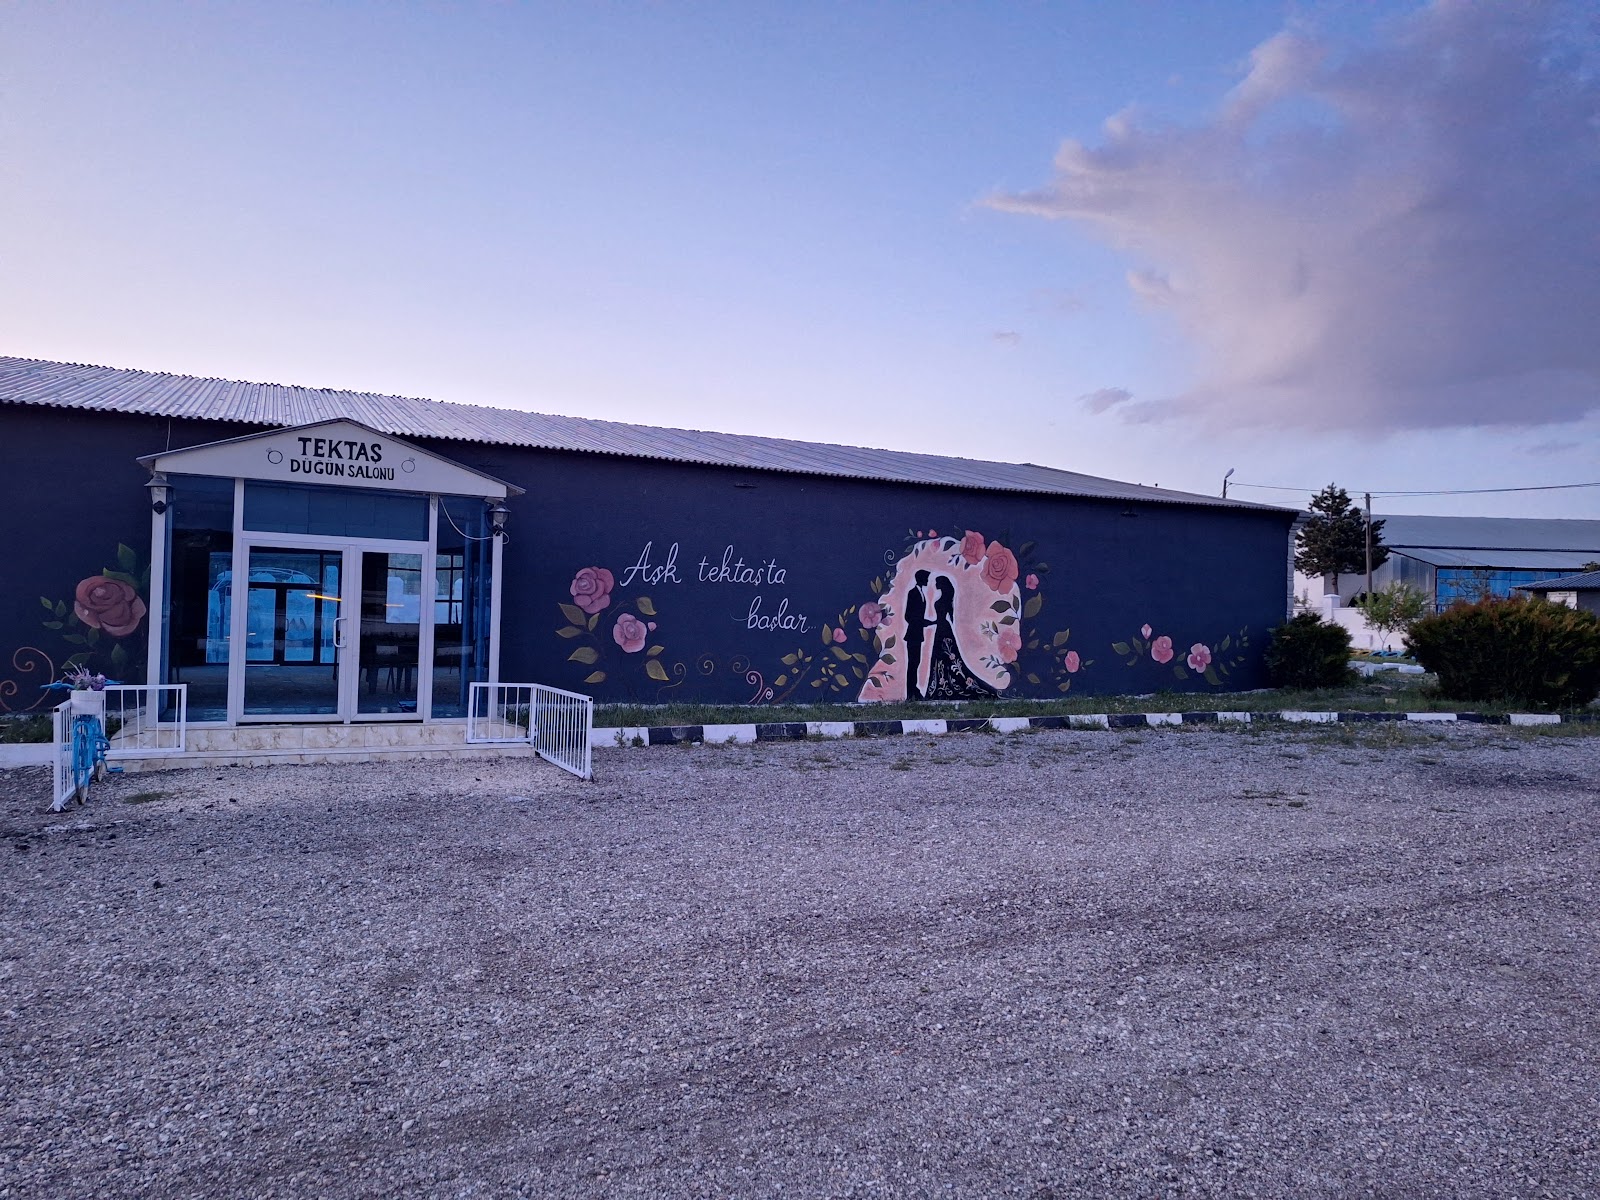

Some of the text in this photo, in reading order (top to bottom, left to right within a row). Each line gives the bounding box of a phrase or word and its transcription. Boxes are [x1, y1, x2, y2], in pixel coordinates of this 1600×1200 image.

[298, 437, 382, 464] TEKTAŞ
[290, 458, 395, 481] DÜĞÜN SALONU
[619, 540, 682, 587] Aşk
